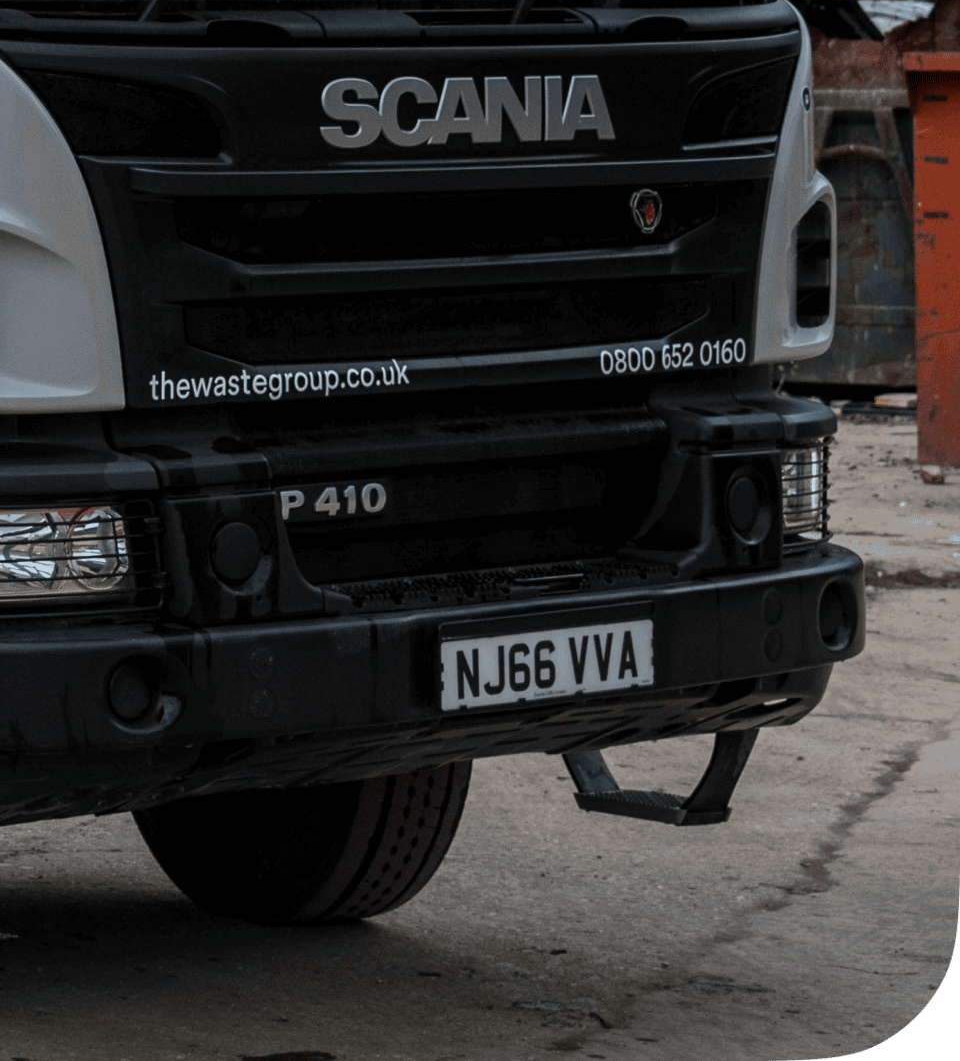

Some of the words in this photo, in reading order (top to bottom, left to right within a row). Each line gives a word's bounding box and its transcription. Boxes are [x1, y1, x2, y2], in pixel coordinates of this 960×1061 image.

[319, 74, 616, 149] SCANIA
[599, 345, 656, 375] 0800
[661, 339, 694, 370] 652
[699, 337, 746, 366] 0160
[149, 358, 410, 401] thewastegroup.co.uk
[279, 489, 305, 520] P
[314, 482, 387, 516] 410
[455, 638, 557, 701] NJ66
[567, 629, 640, 686] VVA
